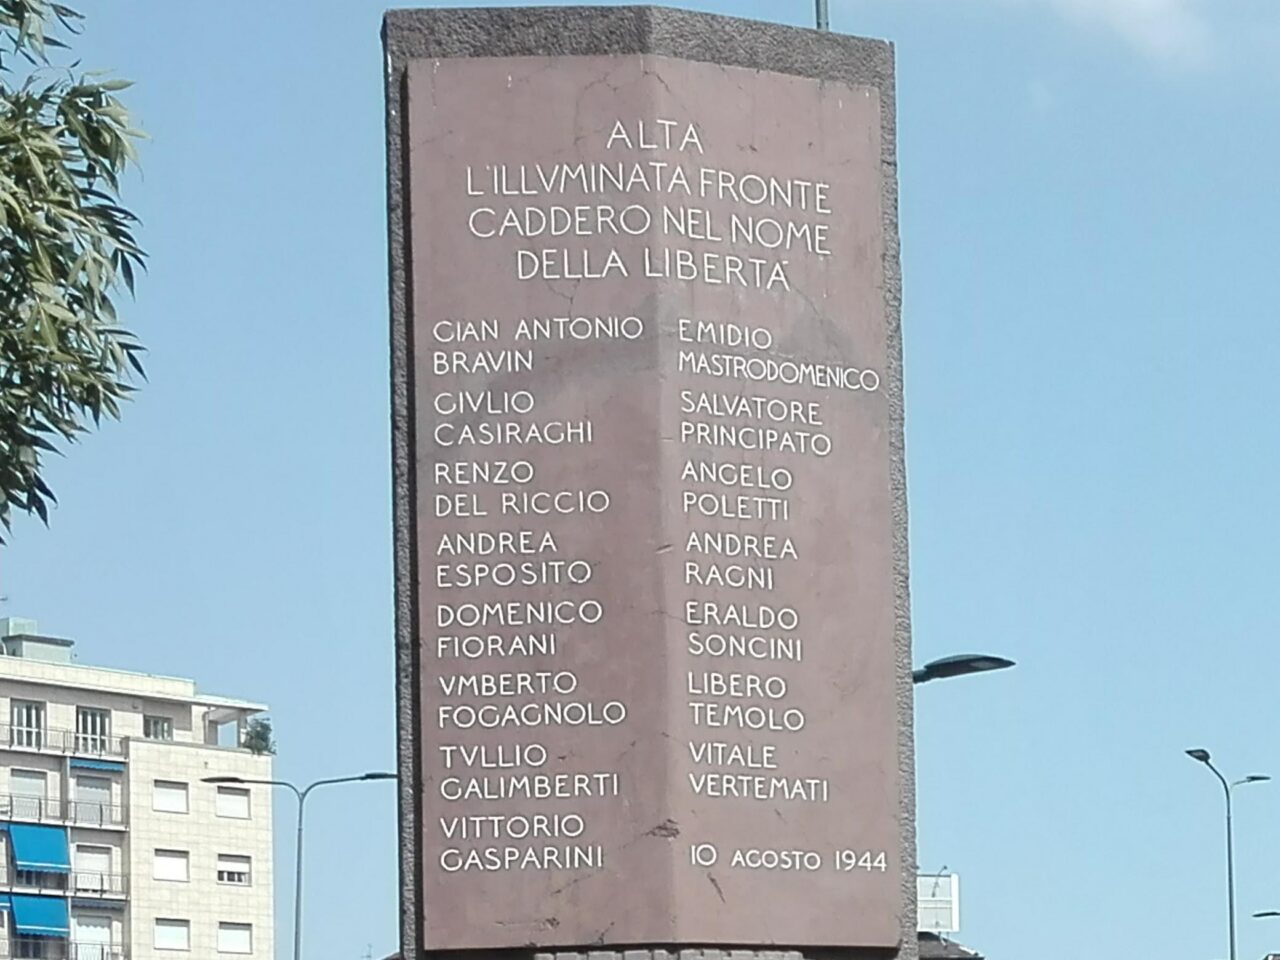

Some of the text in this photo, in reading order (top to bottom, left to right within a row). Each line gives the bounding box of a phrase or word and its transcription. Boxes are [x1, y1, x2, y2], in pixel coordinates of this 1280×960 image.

[606, 118, 704, 154] ALTA
[700, 167, 832, 215] FRONTE
[468, 204, 832, 255] CADDERO NEL NOME
[517, 248, 629, 280] DELLA
[432, 316, 644, 343] GIAN ANTONIO
[678, 318, 772, 350] EMIDIO
[433, 349, 533, 376] BRAVIN
[678, 350, 880, 392] MASTRODOMENICO
[433, 390, 535, 415] GIVLIO
[680, 390, 824, 427] SALVATORE
[433, 420, 592, 447] CASIRAGHI
[681, 422, 832, 456] PRINCIPATO
[434, 460, 534, 485] RENZO
[681, 460, 793, 491] ANGELO
[435, 490, 610, 518] DEL RICCIO
[683, 490, 788, 521] POLETTI
[436, 530, 558, 556] ANDREA
[685, 531, 798, 560] ANDREA
[436, 560, 592, 588] ESPOSITO
[685, 560, 774, 590] RAGNI
[437, 599, 603, 628] DOMENICO
[685, 600, 798, 631] ERALDO
[437, 632, 556, 659] FIORANI
[687, 631, 802, 662] SONCINI
[438, 671, 578, 697] VMBERTO
[687, 671, 787, 699] LIBERO
[438, 699, 626, 729] FOGAGNOLO
[688, 701, 805, 731] TEMOLO
[438, 743, 547, 769] TVLLIO
[688, 741, 778, 772] VITALE
[440, 771, 618, 801] GALIMBERTI
[688, 771, 828, 802] VERTEMATI
[439, 814, 585, 841] VITTORIO
[440, 844, 603, 872] GASPARINI
[690, 843, 888, 872] 10 AGOSTO 1944
